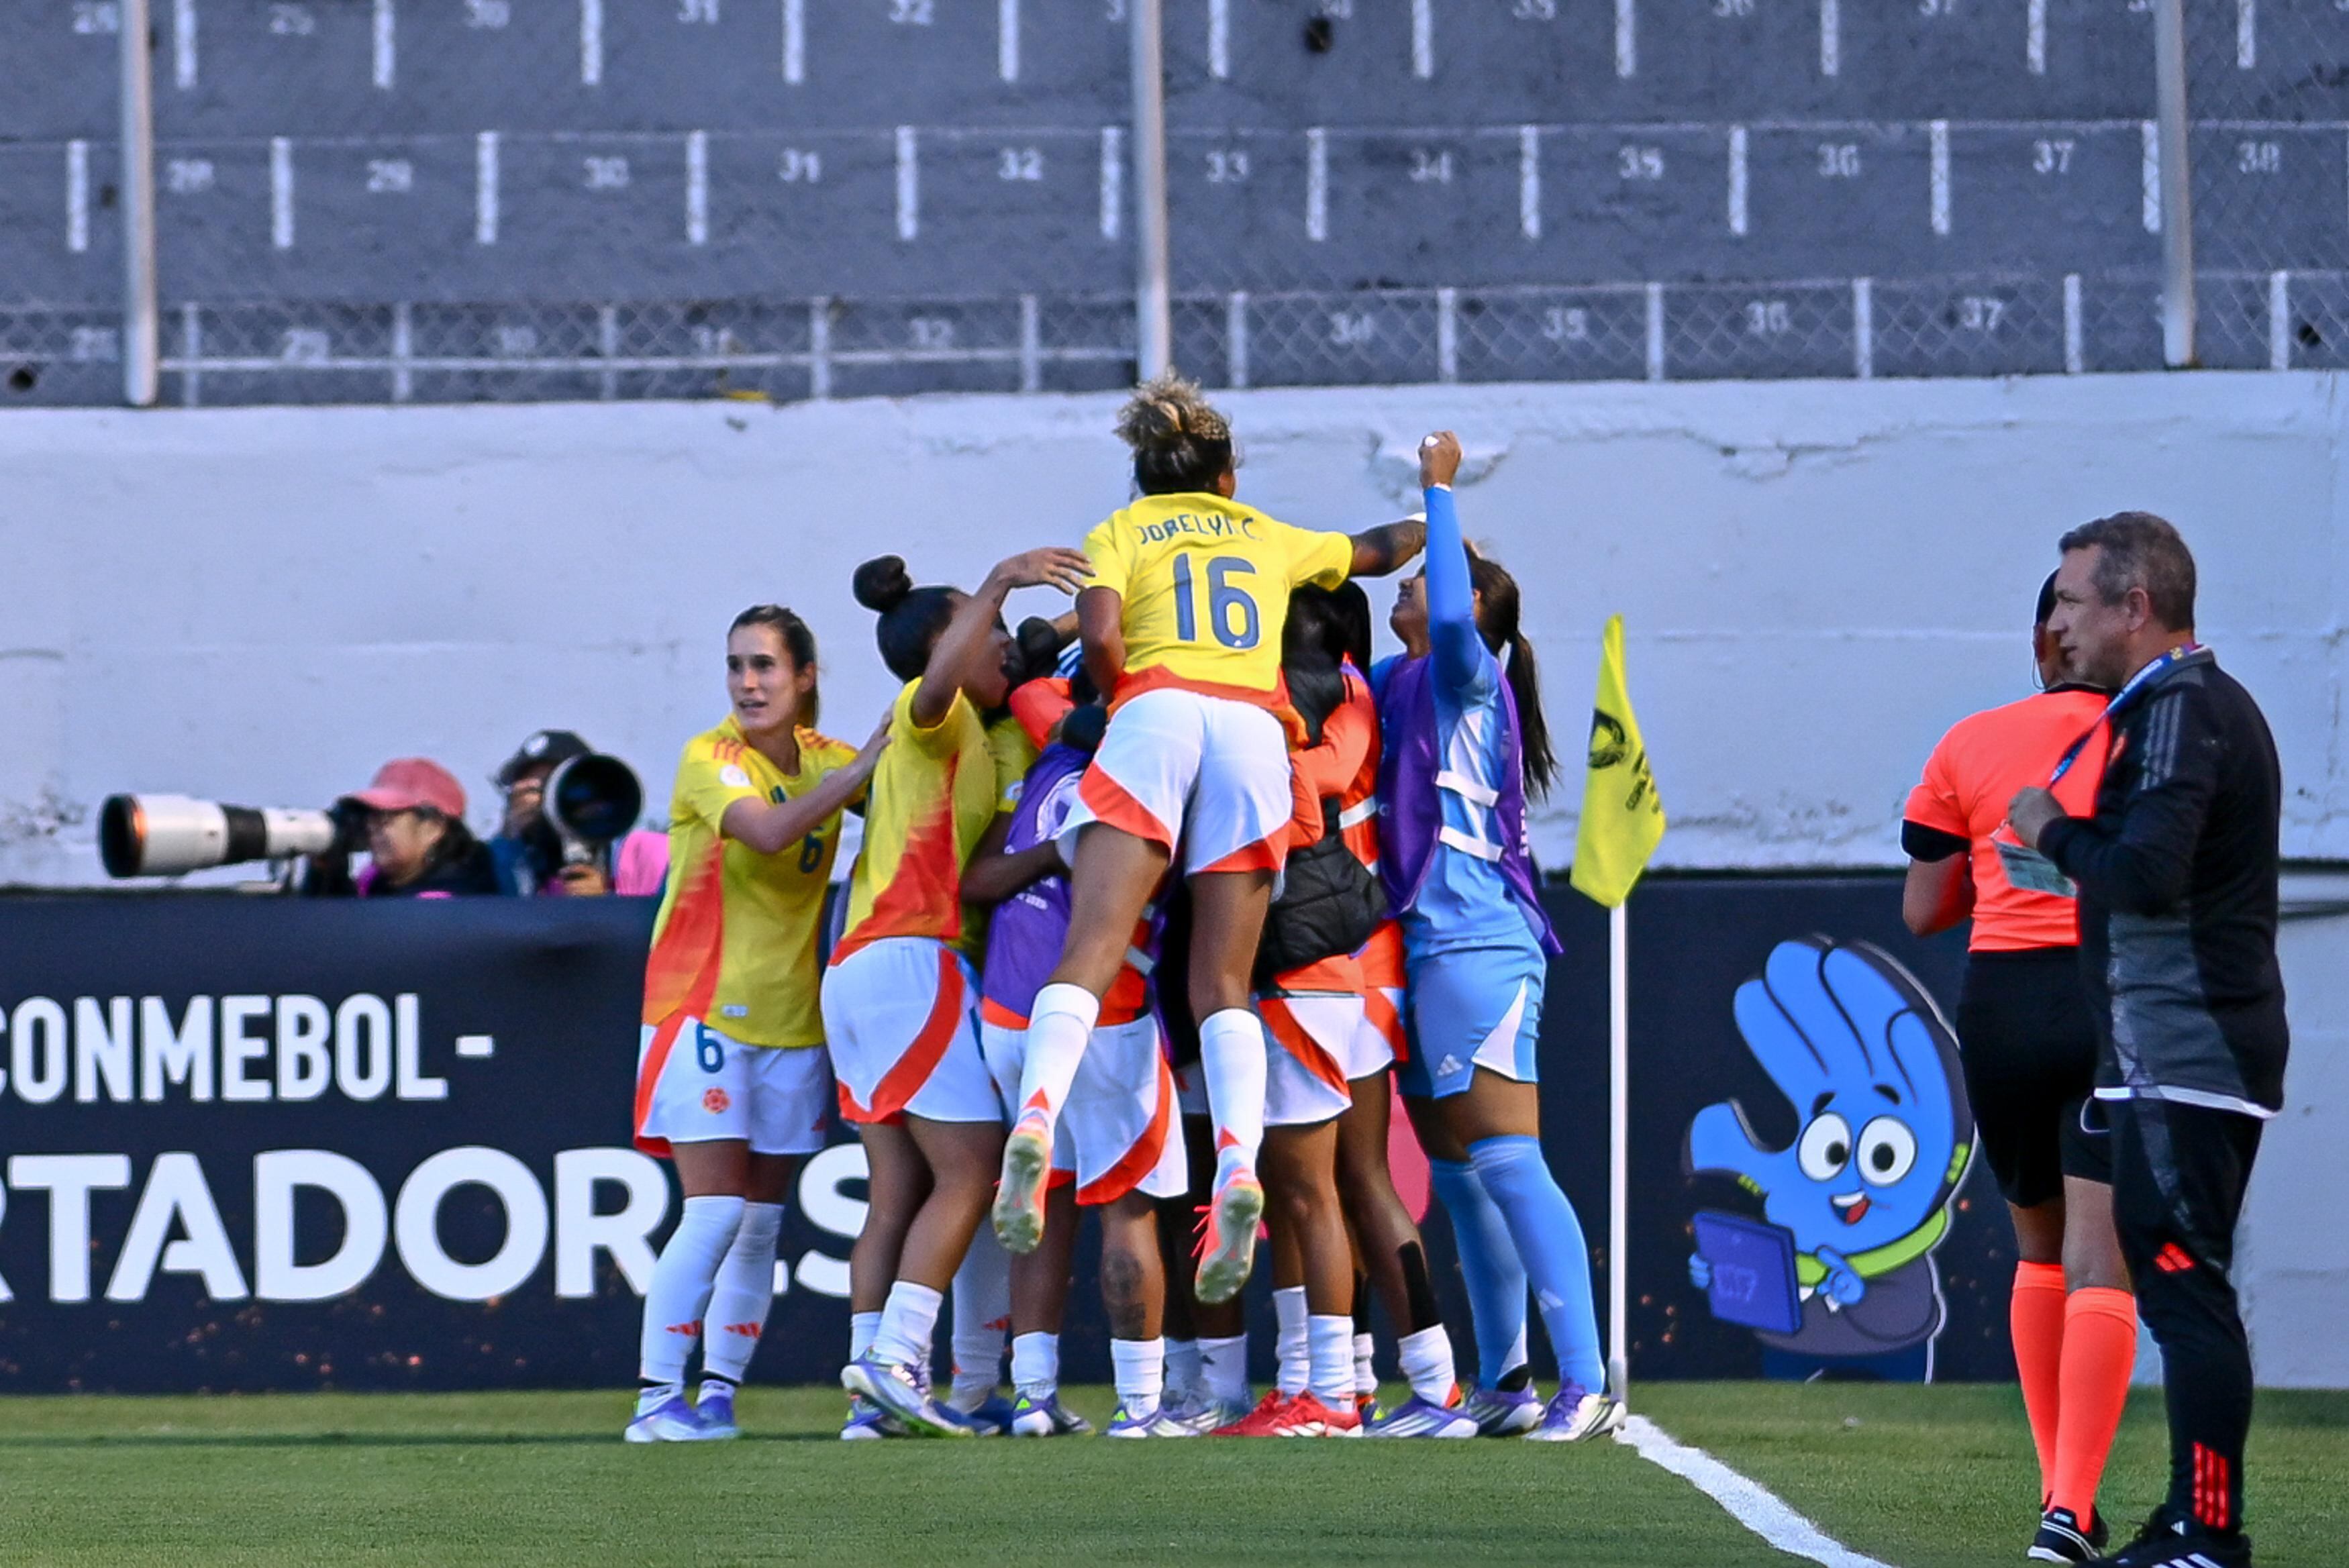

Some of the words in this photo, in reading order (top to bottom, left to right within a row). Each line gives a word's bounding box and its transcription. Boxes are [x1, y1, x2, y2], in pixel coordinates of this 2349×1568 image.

[779, 148, 820, 182] 31
[999, 147, 1042, 180] 32
[1206, 150, 1248, 182] 33
[1409, 149, 1452, 182] 34
[1618, 146, 1663, 179] 35
[1818, 144, 1860, 176] 36
[2033, 140, 2074, 173] 37
[1963, 297, 2003, 331] 37
[1174, 552, 1260, 648] 16
[0, 994, 494, 1103] ONMEBOL-
[696, 1023, 724, 1074] 6
[0, 1143, 870, 1302] TADORS
